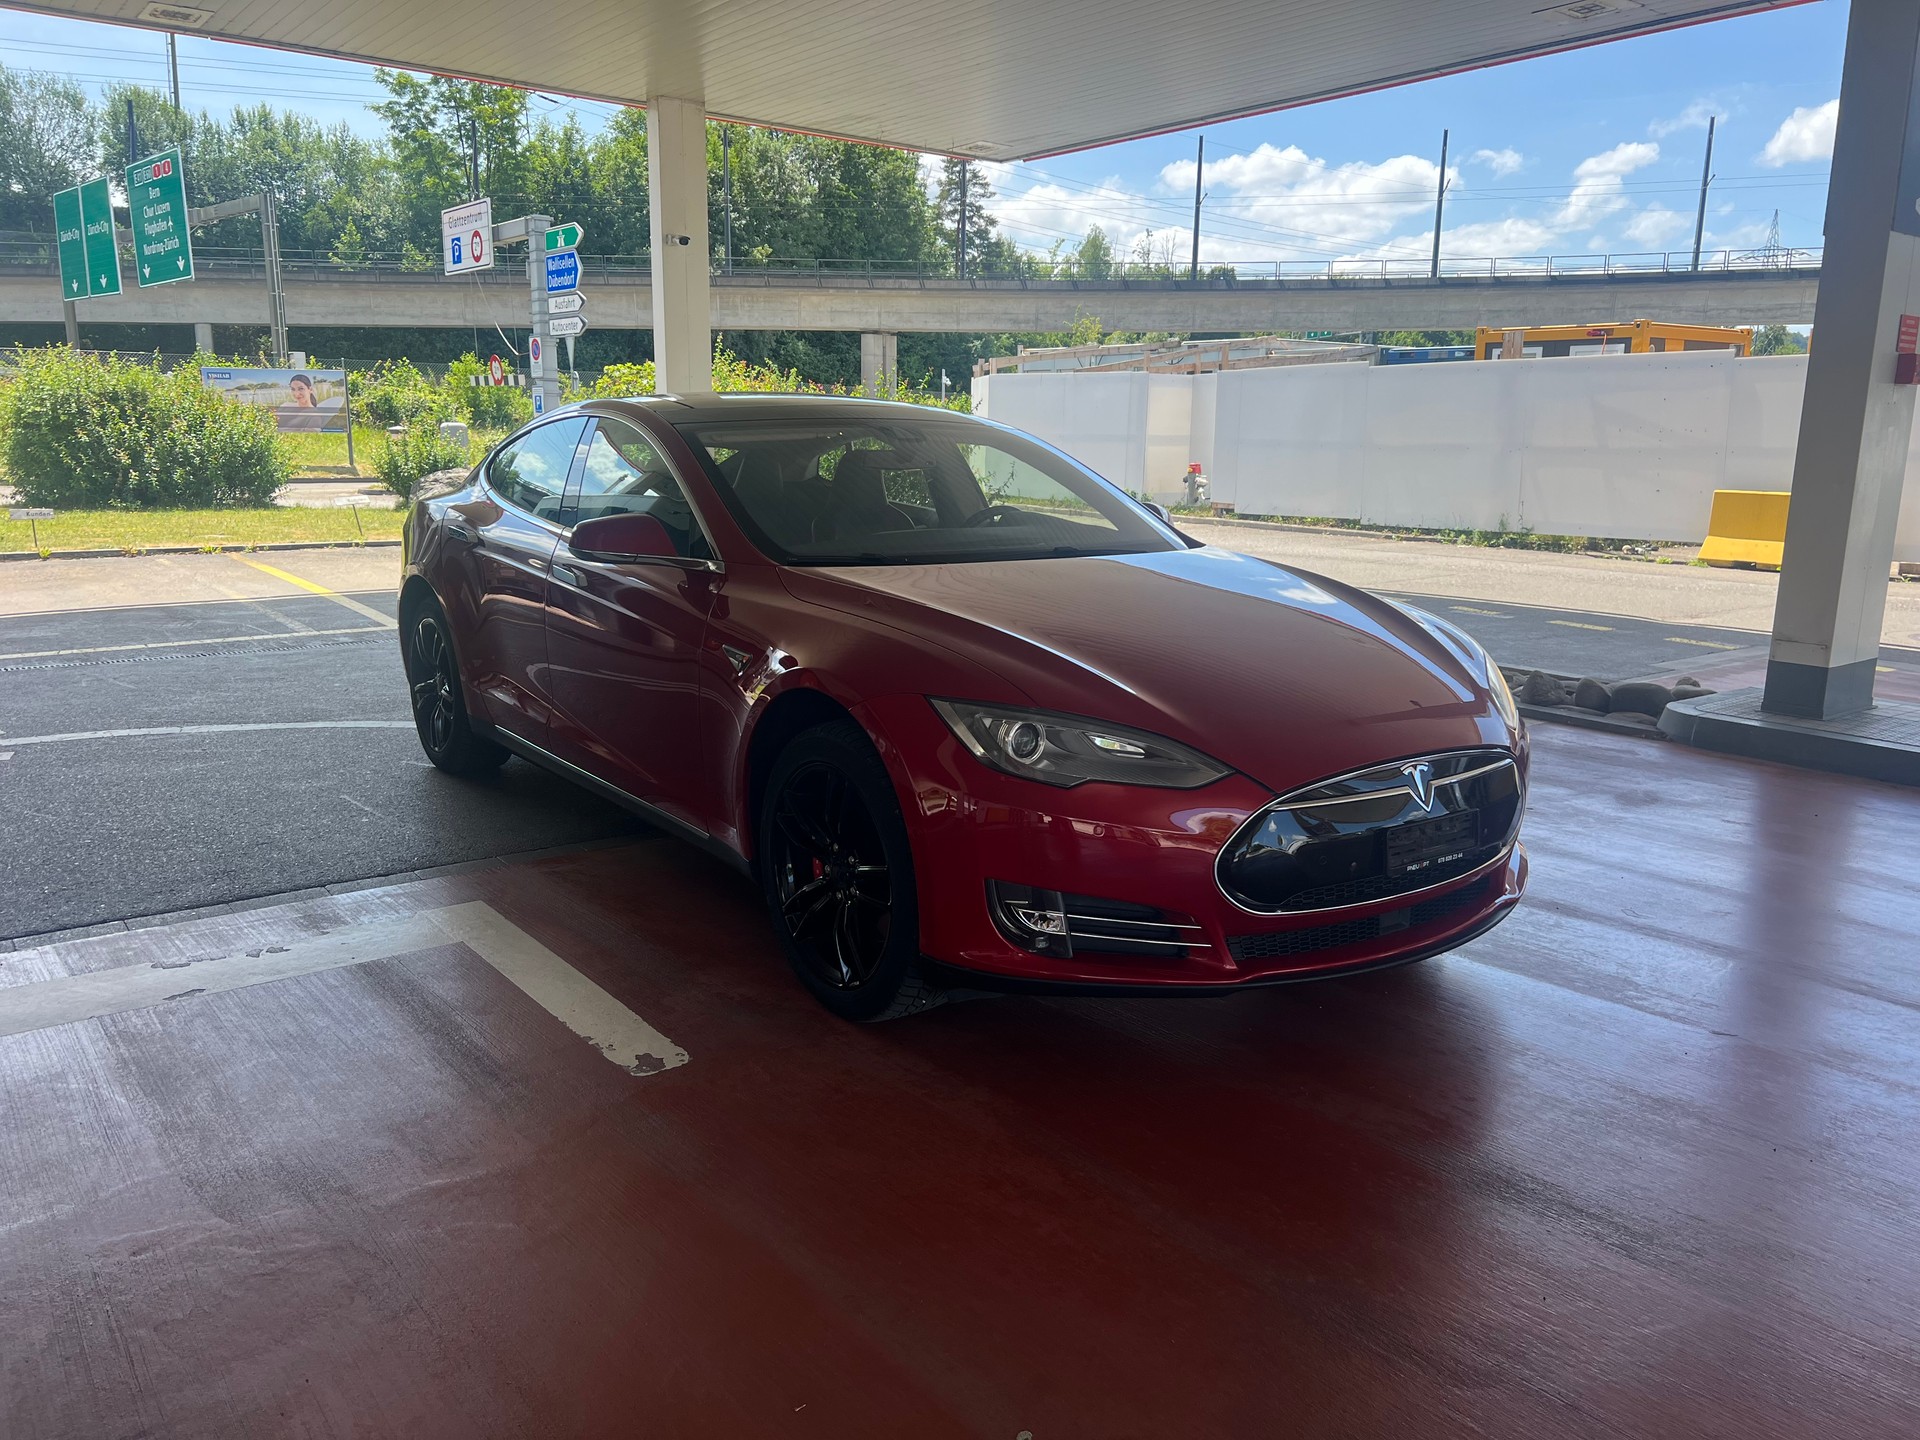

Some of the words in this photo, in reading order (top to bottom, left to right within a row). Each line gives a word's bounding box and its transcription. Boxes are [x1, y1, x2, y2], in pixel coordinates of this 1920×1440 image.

[149, 187, 160, 199] Bern
[154, 202, 170, 215] Luzern
[144, 218, 167, 236] Flughafen
[448, 212, 482, 229] Glattzentrum
[60, 229, 80, 242] Zürich-City
[87, 221, 109, 236] Zürich-City
[143, 235, 179, 256] Nordring-Zürich
[547, 255, 575, 271] Wallisellen
[548, 271, 575, 288] Dübendorf
[555, 299, 576, 310] Ausfahrt
[552, 322, 578, 333] Autocenter
